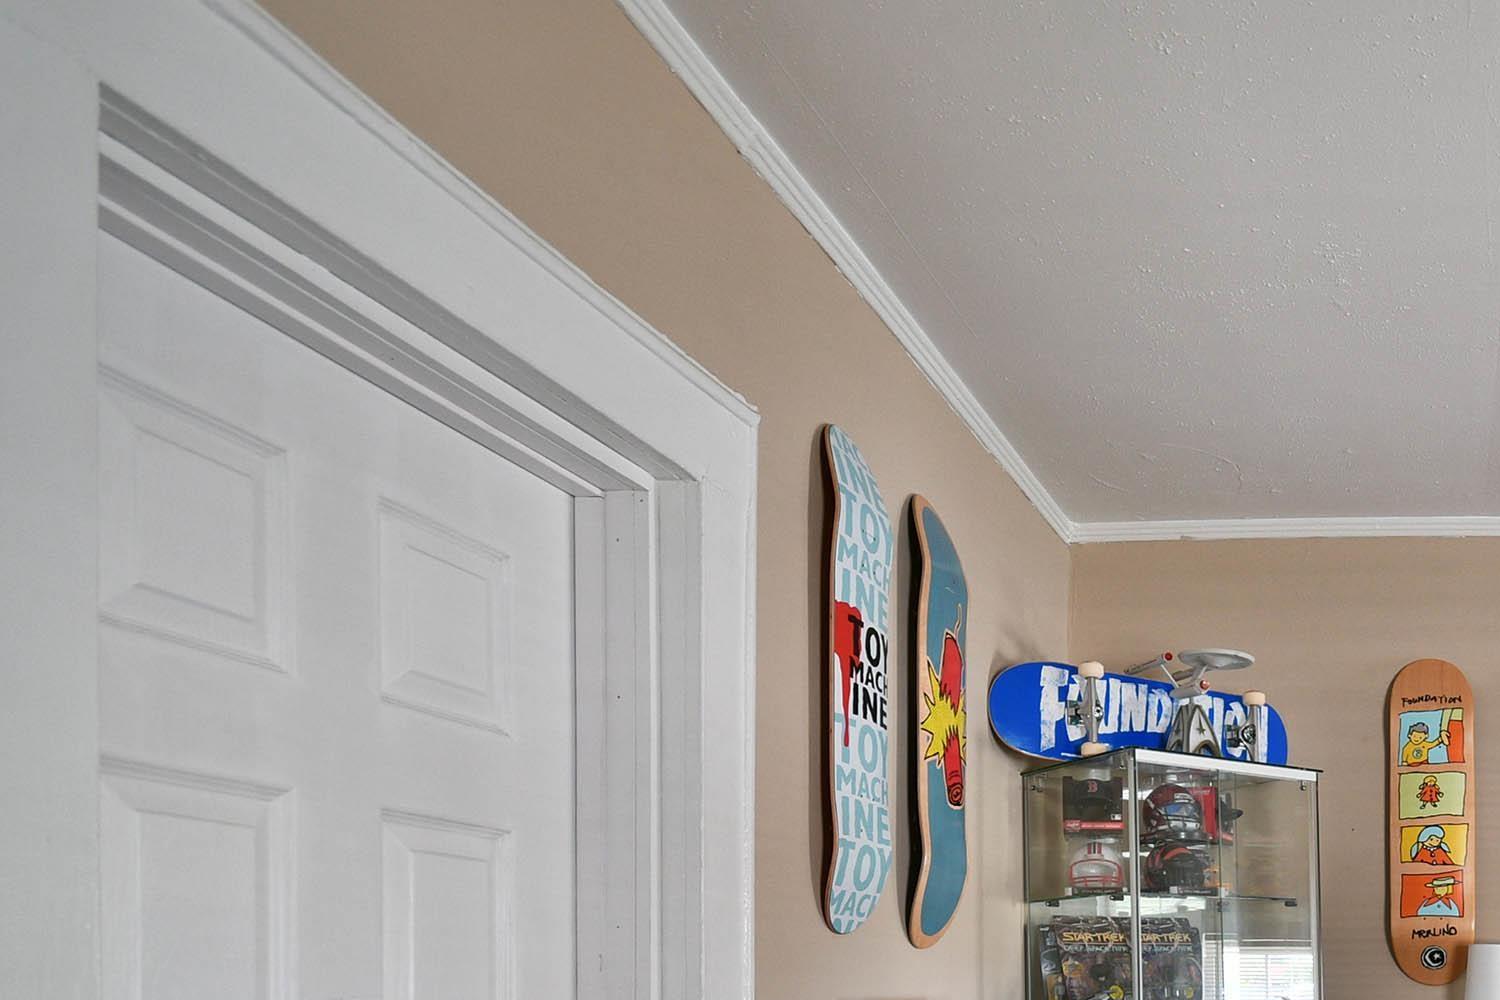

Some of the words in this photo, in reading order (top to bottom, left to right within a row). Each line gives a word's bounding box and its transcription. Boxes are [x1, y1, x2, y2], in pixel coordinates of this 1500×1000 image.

[848, 614, 888, 675] TOY
[852, 682, 888, 730] INE
[1401, 694, 1463, 708] FOUNDATION
[841, 795, 891, 847] INE
[835, 838, 892, 894] TOY
[1062, 931, 1094, 942] STAR
[1141, 932, 1161, 942] TAR
[1162, 930, 1191, 942] TREK
